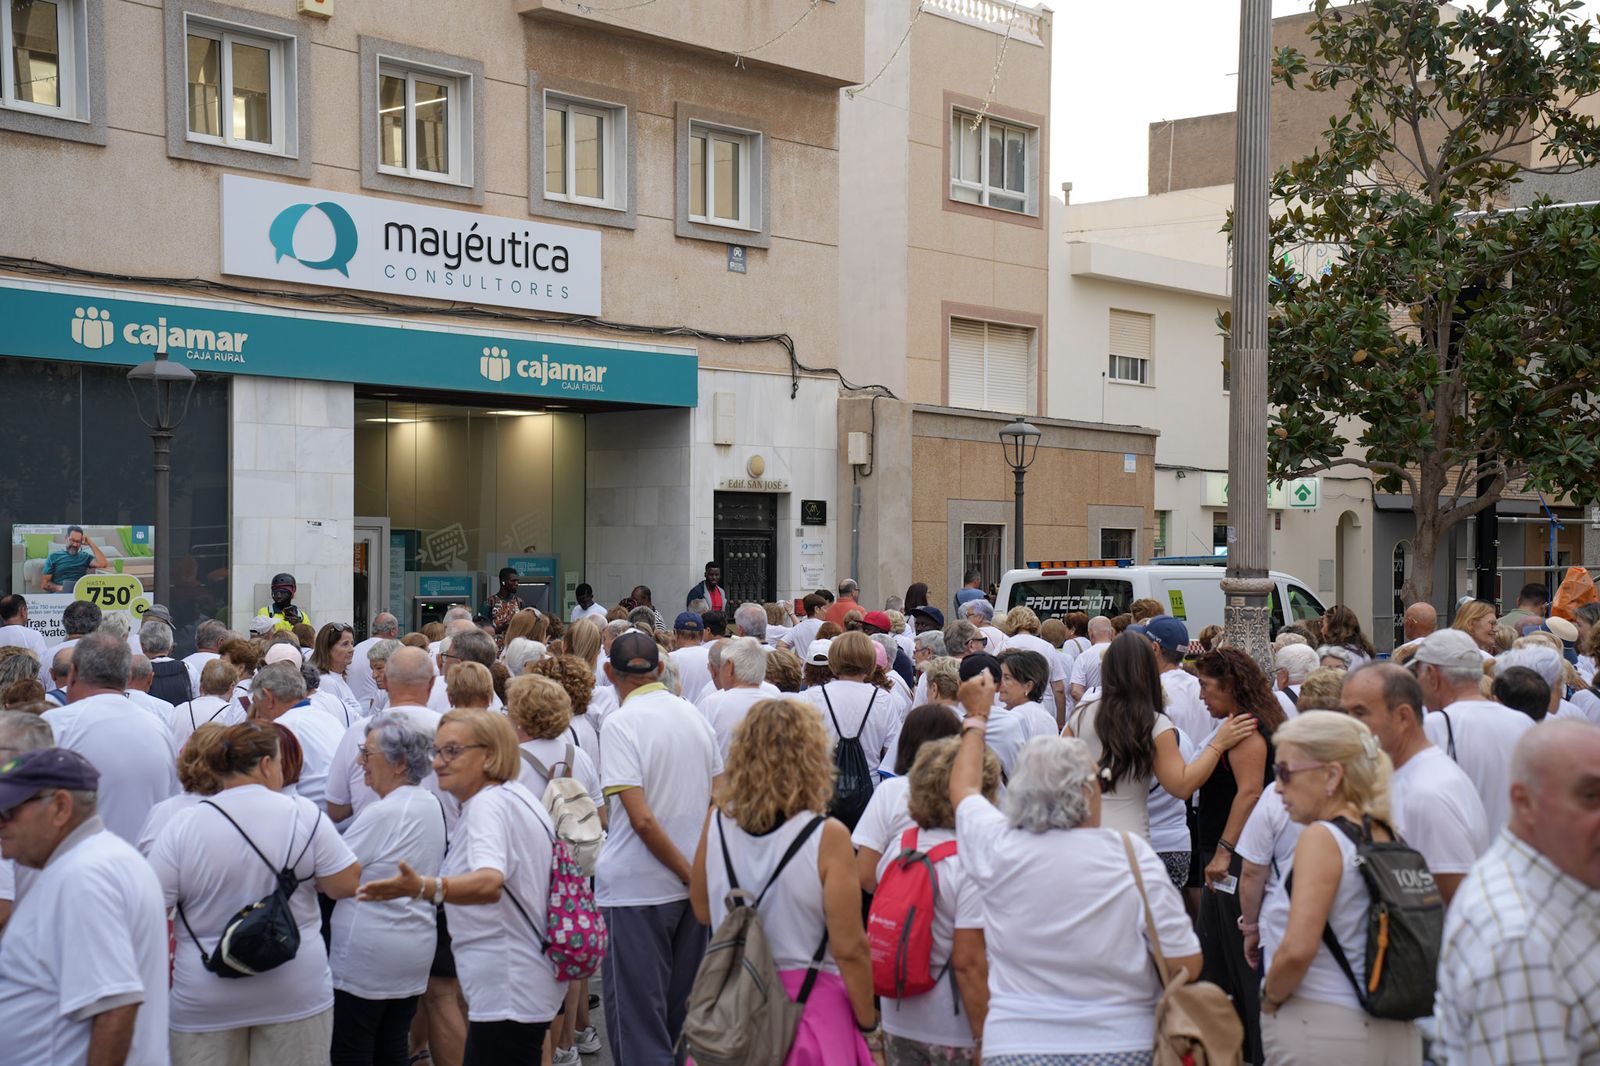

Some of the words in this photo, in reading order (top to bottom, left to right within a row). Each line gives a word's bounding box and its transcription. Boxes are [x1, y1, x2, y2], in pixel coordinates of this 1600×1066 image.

[384, 221, 569, 273] mayéutica
[384, 264, 569, 299] CONSULTORES
[123, 317, 249, 353] cajamar
[186, 350, 212, 360] CAJA
[214, 352, 246, 363] RURAL
[516, 354, 607, 386] cajamar
[561, 382, 580, 390] CAJA
[582, 383, 605, 392] RURAL
[728, 479, 746, 489] Edif.
[747, 480, 763, 489] SAN
[764, 478, 782, 491] JOSÉ
[1024, 593, 1114, 610] PROTECCIÓN
[26, 618, 47, 628] Trae
[50, 618, 60, 627] tu
